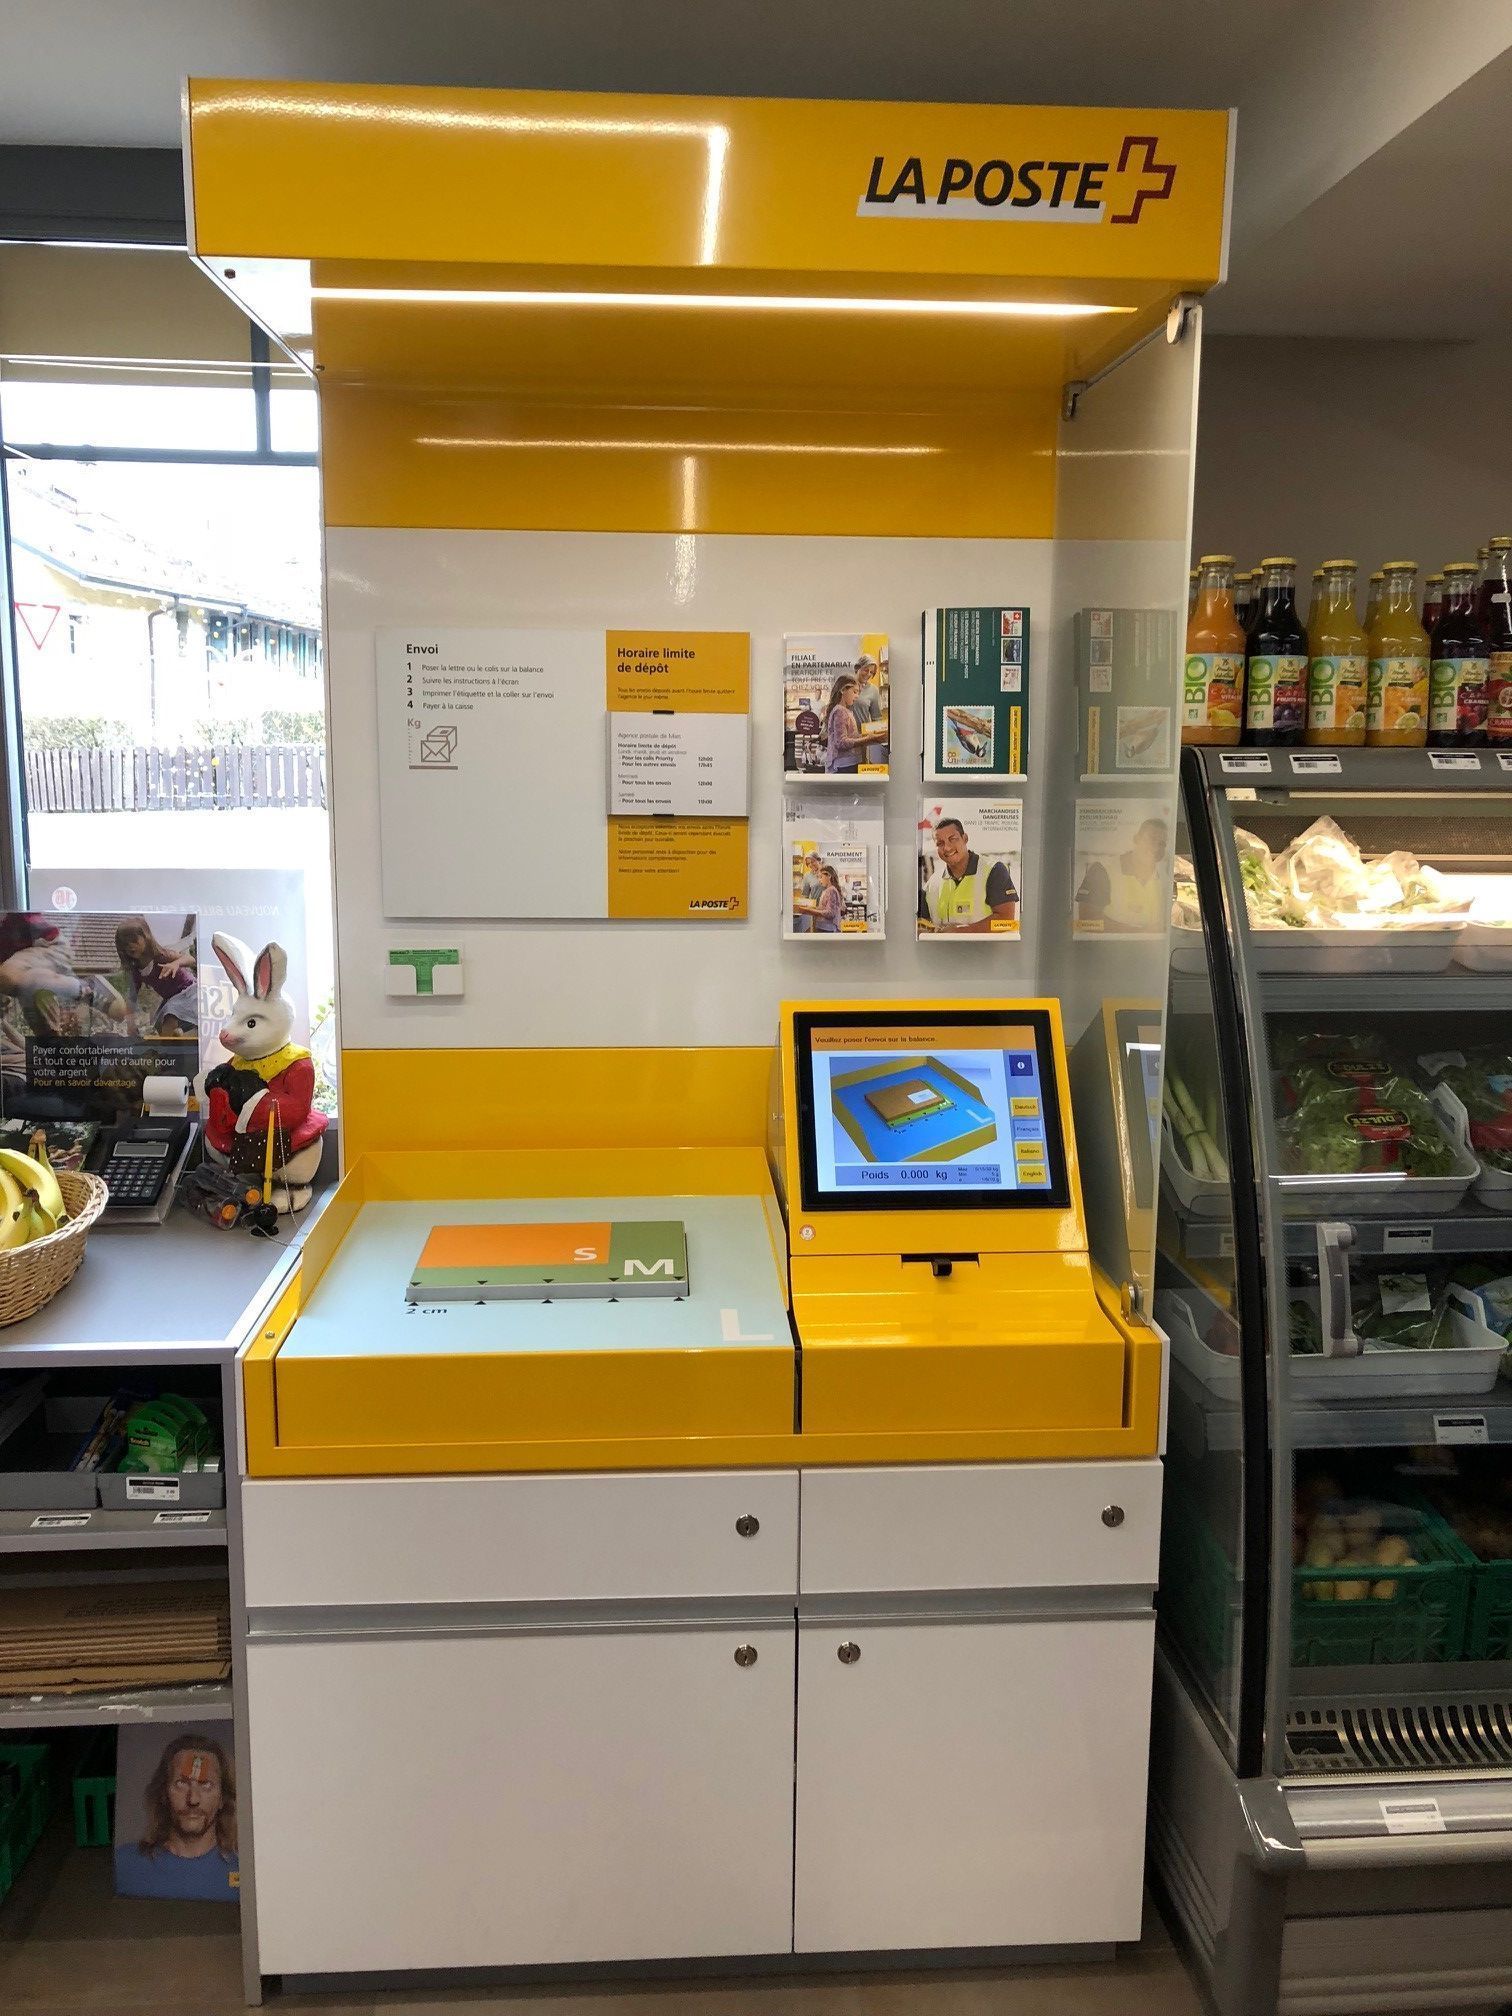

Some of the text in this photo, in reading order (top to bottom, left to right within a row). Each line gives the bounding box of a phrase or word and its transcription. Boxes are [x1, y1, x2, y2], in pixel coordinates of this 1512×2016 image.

[865, 156, 1109, 209] LA POSTE
[406, 644, 439, 654] Envoi
[617, 648, 695, 659] Horaire limite
[407, 662, 412, 670] 1
[519, 665, 544, 673] balance
[617, 662, 669, 675] de dépôt
[791, 661, 852, 669] EN PARTENARIAT
[407, 675, 412, 683] 2
[1185, 657, 1207, 703] BIO
[1249, 659, 1273, 705] BIO
[1311, 660, 1334, 706] BIO
[1433, 662, 1457, 708] BIO
[407, 688, 413, 696] 3
[423, 690, 452, 698] Imprimer
[453, 690, 486, 698] l'étiquette
[407, 701, 413, 709] 4
[407, 718, 421, 729] Kg
[690, 900, 729, 908] LA POSTE
[33, 1045, 133, 1056] Payer confortablement
[34, 1057, 42, 1066] Et
[45, 1057, 63, 1066] tout
[79, 1057, 97, 1068] qu'il
[101, 1057, 118, 1066] faut
[121, 1057, 152, 1066] d'autre
[154, 1058, 176, 1068] pour
[59, 1068, 88, 1078] argent
[34, 1079, 52, 1087] Pour
[94, 1079, 137, 1089] davantage
[861, 1169, 948, 1181] Poids 0.000 kg
[573, 1247, 597, 1262] S
[624, 1258, 674, 1276] M
[405, 1307, 416, 1315] 2
[721, 1308, 775, 1341] L
